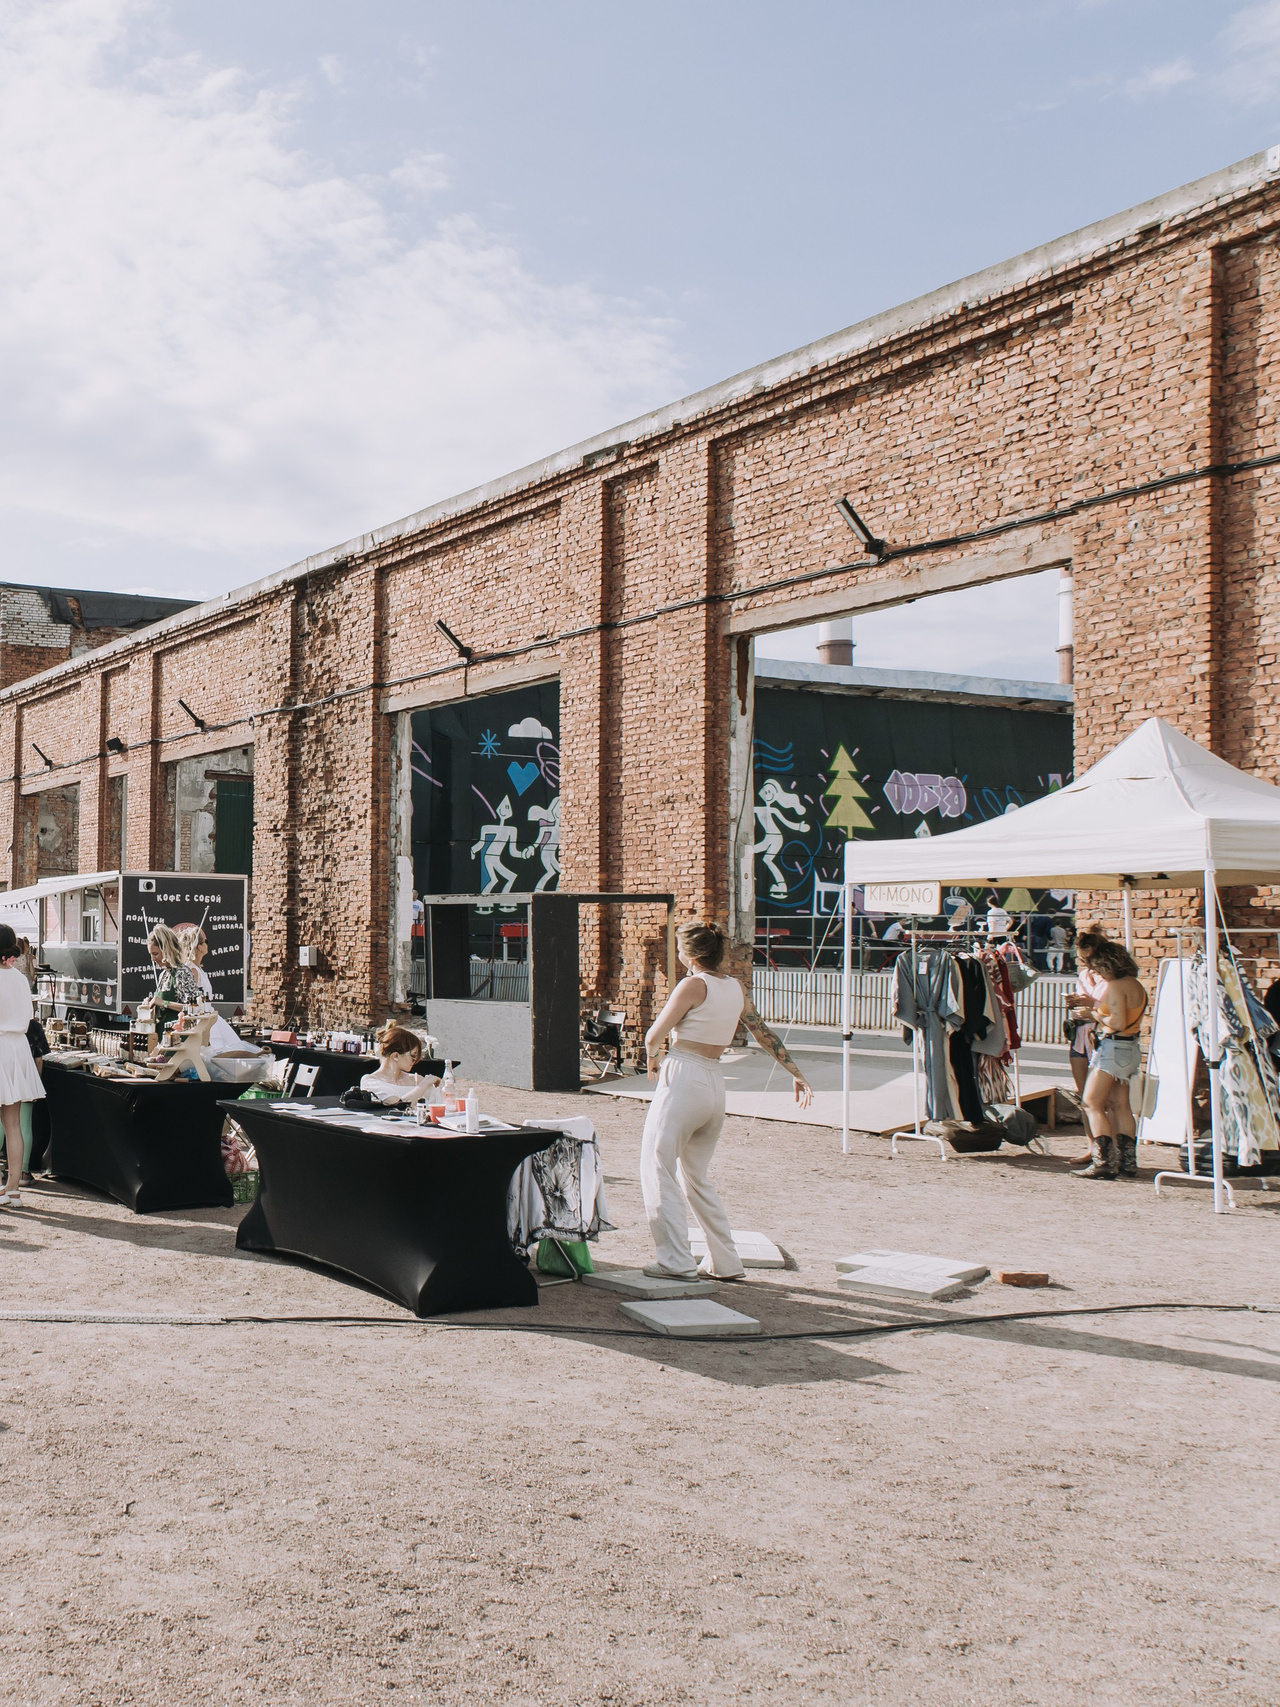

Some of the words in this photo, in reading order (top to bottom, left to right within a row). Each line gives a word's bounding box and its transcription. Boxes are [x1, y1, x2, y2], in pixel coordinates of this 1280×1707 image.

[156, 894, 181, 902] КОФЕ
[185, 894, 190, 902] С
[193, 894, 222, 904] СОБОЙ
[209, 914, 237, 922] ГОРЯЧИЙ
[212, 923, 244, 931] ШОКОЛАД
[127, 936, 148, 945] ПЫШ
[211, 944, 240, 956] КАКАО
[227, 967, 244, 976] КОФЕ
